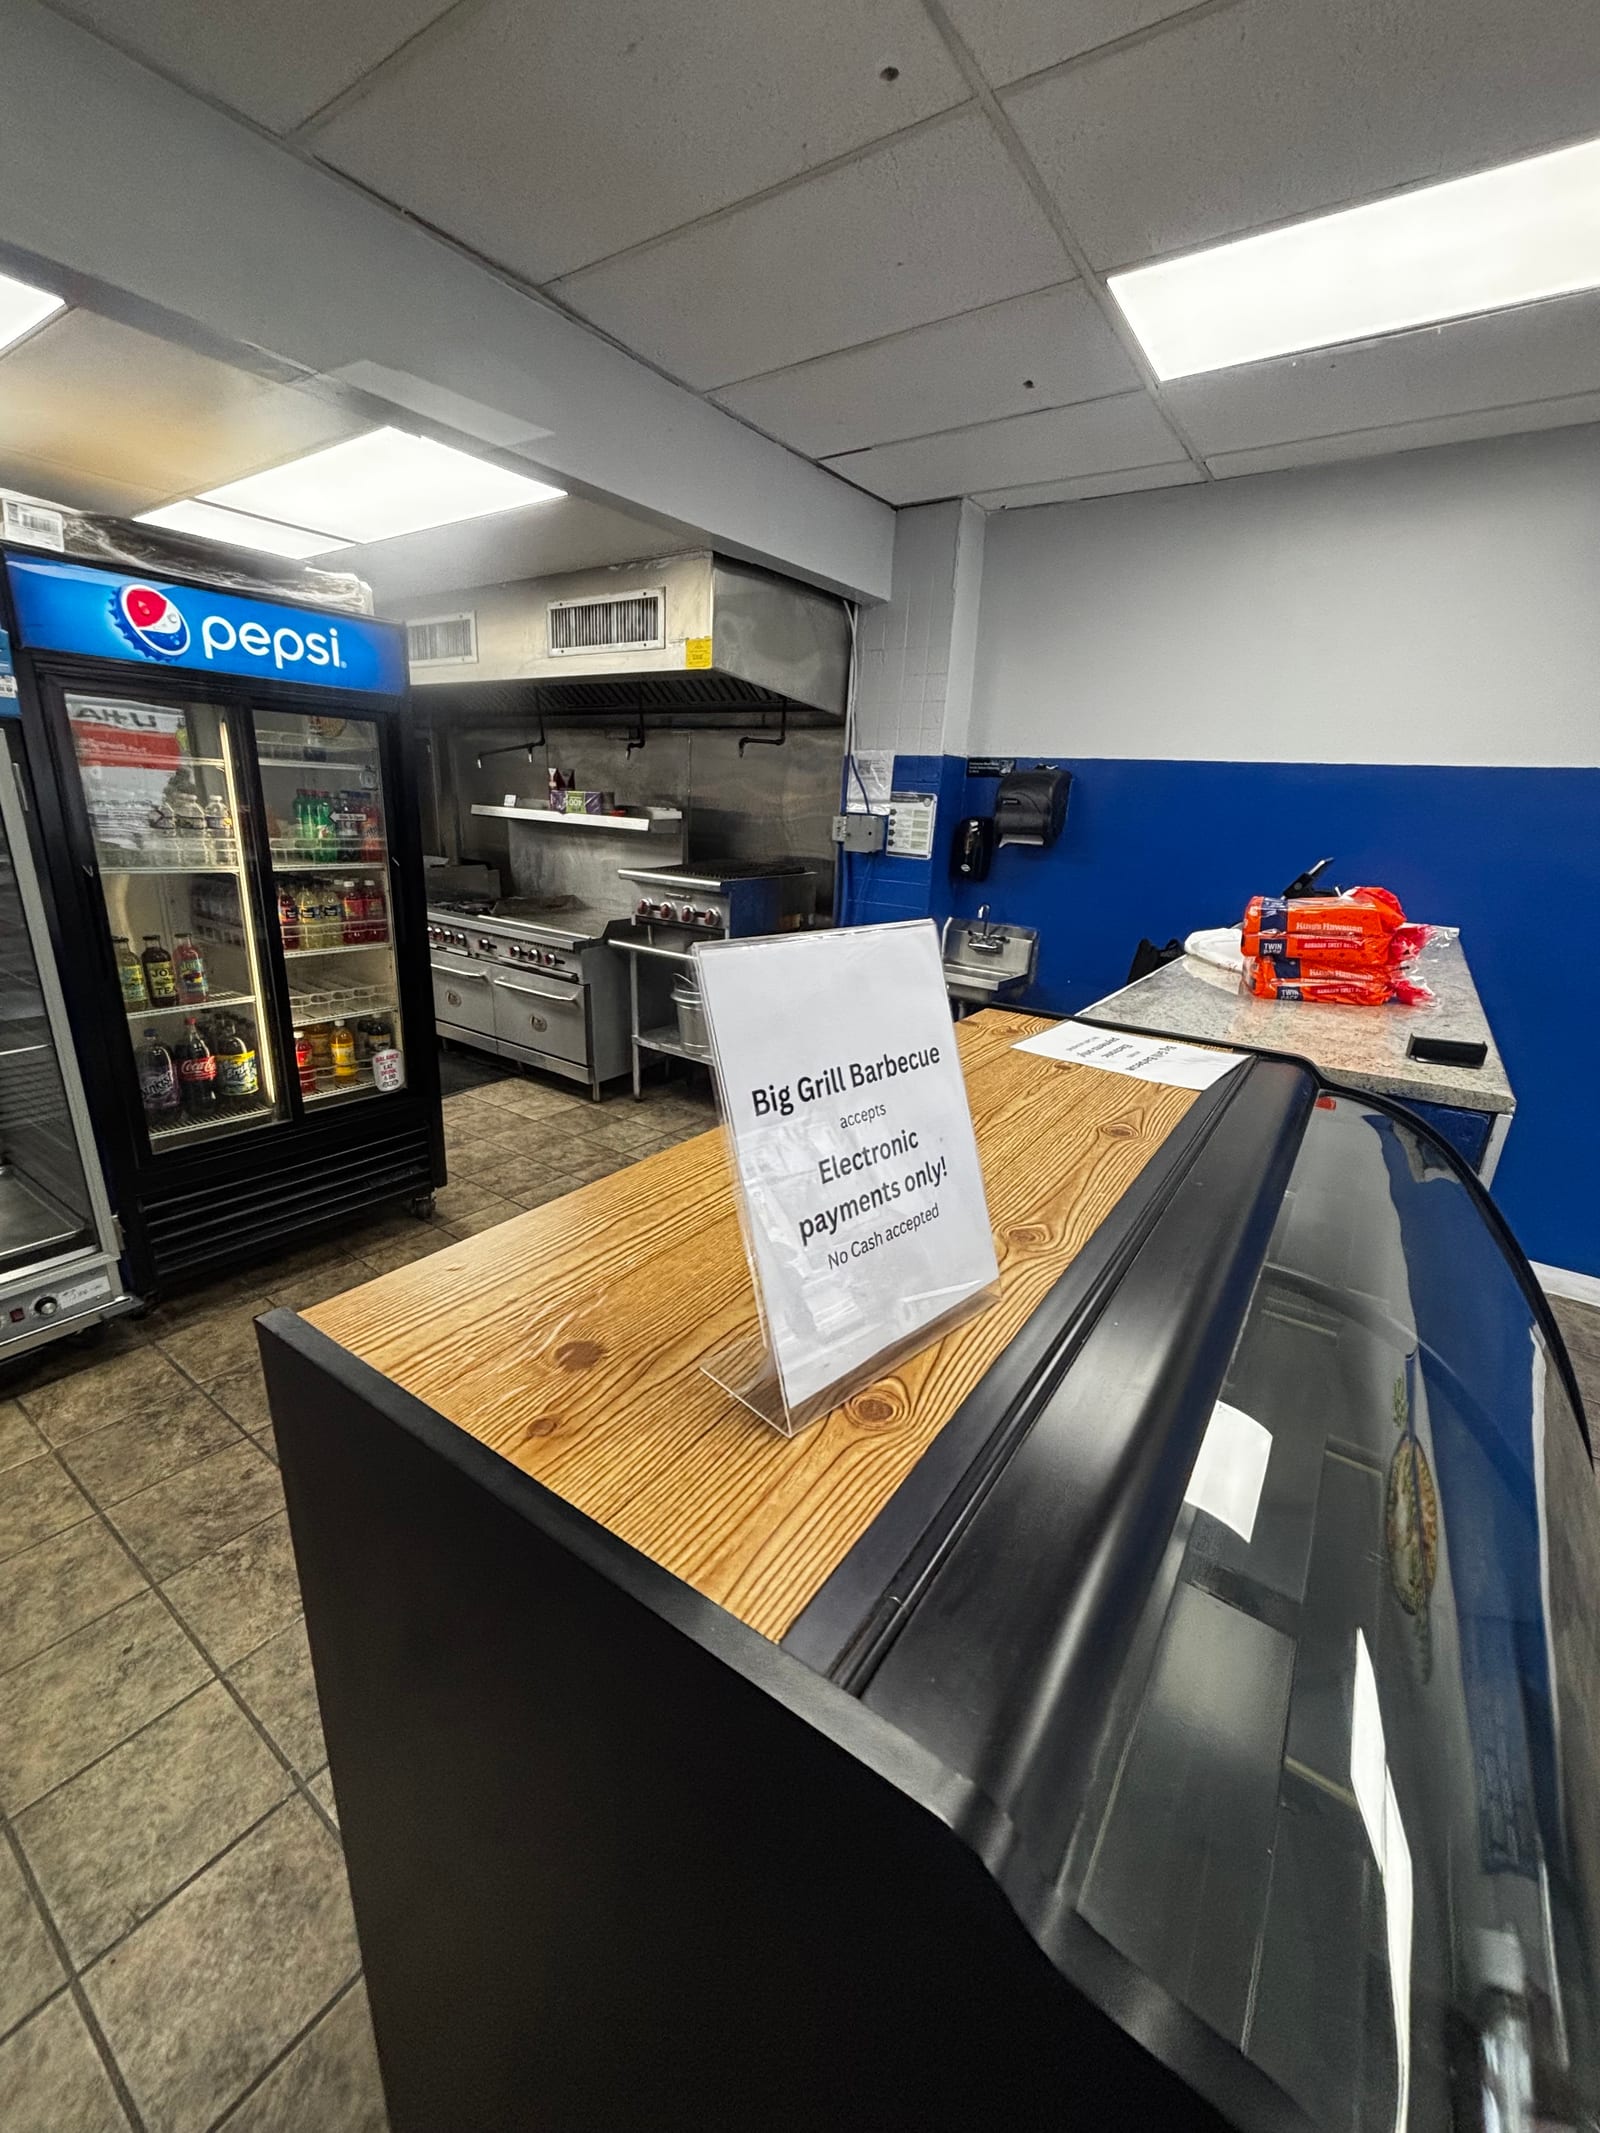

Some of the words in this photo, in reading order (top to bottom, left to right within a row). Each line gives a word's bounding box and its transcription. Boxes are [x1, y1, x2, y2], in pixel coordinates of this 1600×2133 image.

[202, 615, 341, 669] pepsi
[752, 1084, 794, 1116] Big
[797, 1066, 846, 1102] Grill
[849, 1047, 940, 1088] Barbecue
[839, 1103, 886, 1129] accepts
[818, 1129, 919, 1184] Electronic
[799, 1180, 901, 1246] payments
[904, 1156, 947, 1192] only!
[828, 1251, 848, 1270] No
[851, 1231, 883, 1257] Cash
[885, 1202, 939, 1242] accepted
